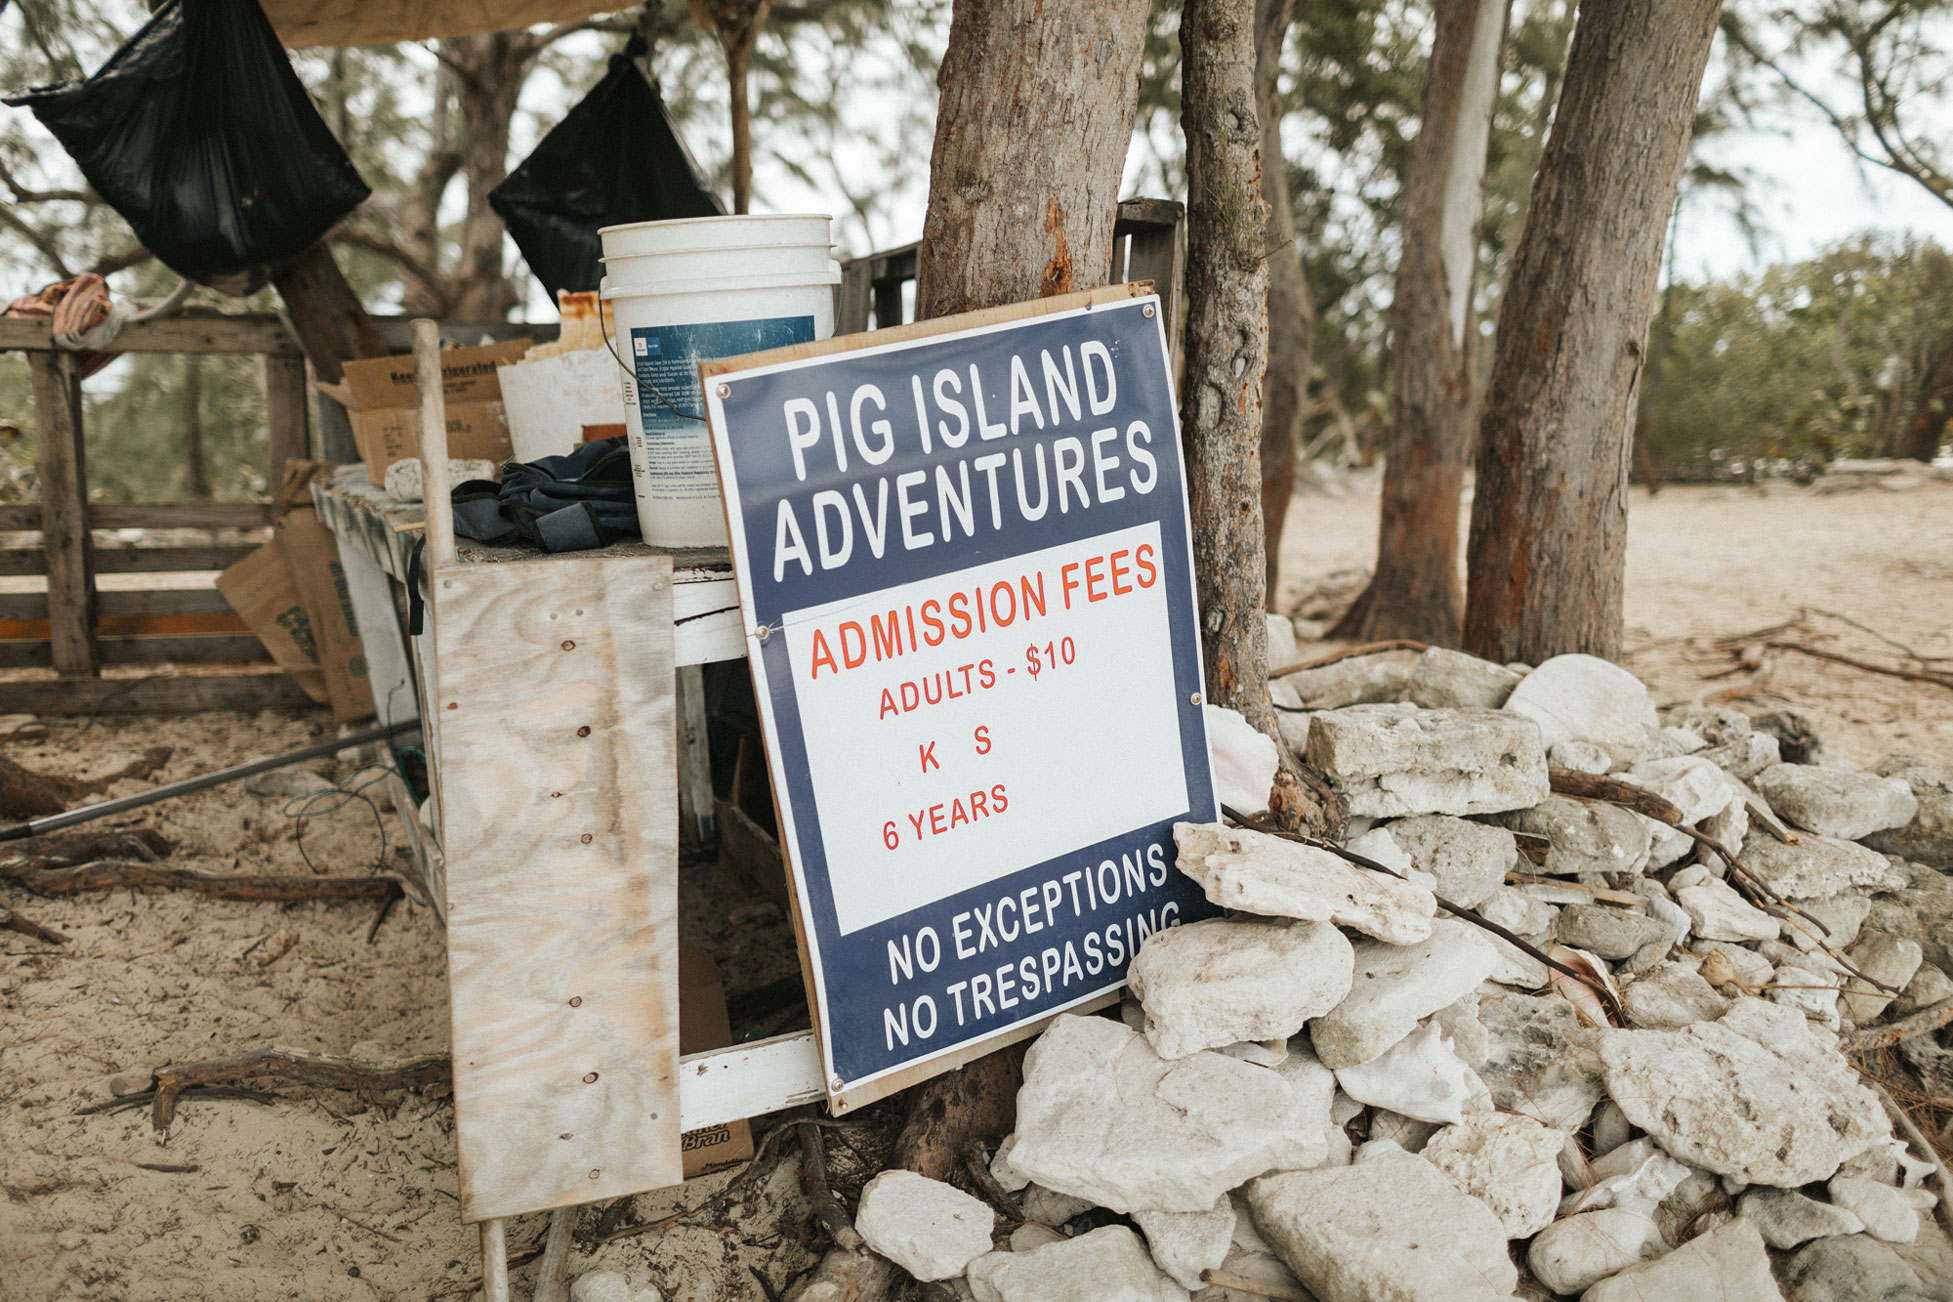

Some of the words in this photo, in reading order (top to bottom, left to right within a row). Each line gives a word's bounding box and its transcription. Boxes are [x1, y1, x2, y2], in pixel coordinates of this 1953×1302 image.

[782, 383, 895, 483] PIG
[911, 339, 1117, 456] ISLAND
[773, 420, 1158, 583] ADVENTURES
[811, 571, 1046, 680] ADMISSION
[1061, 544, 1157, 610] FEES
[879, 659, 996, 720] ADULTS
[1026, 636, 1075, 681] $10
[919, 740, 940, 774] K
[974, 725, 992, 755] S
[883, 821, 899, 851] 6
[908, 784, 1009, 841] YEARS
[887, 926, 941, 986] NO
[952, 843, 1168, 960] EXCEPTIONS
[883, 994, 938, 1051] NO
[682, 1130, 731, 1152] Bran
